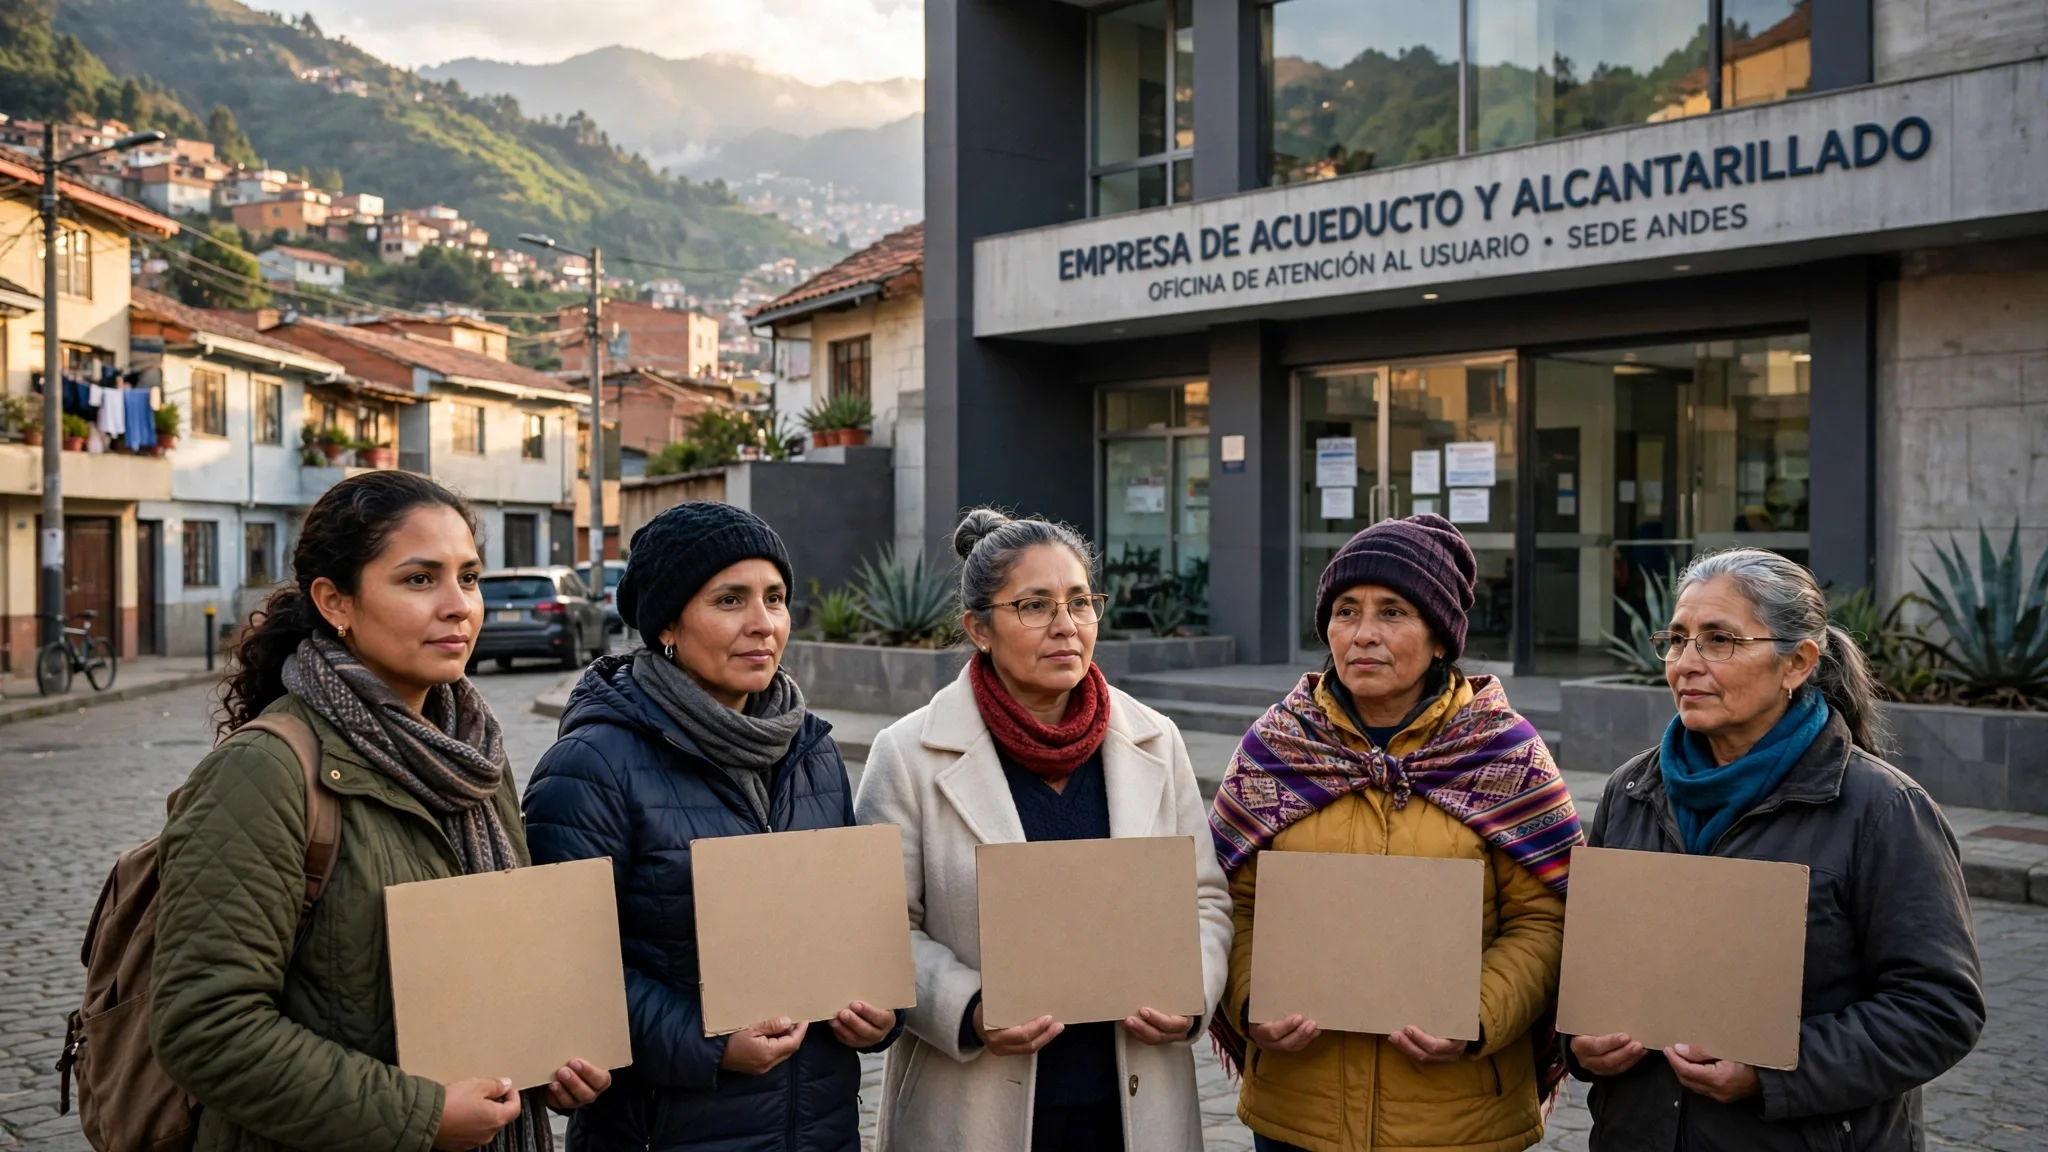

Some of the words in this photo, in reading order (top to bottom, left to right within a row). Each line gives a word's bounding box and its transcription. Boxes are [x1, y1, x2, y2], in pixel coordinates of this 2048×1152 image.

[1058, 231, 1192, 282] EMPRESA
[1199, 222, 1241, 262] DE
[1249, 188, 1465, 255] ACUEDUCTO
[1474, 181, 1502, 222] Y
[1511, 114, 1933, 219] ALCANTARILLADO
[1148, 273, 1227, 302] OFICINA
[1232, 268, 1259, 292] DE
[1264, 249, 1375, 288] ATENCIÓN
[1382, 249, 1413, 273] AL
[1420, 232, 1530, 269] USUARIO
[1567, 217, 1638, 250] SEDE
[1645, 202, 1749, 241] ANDES
